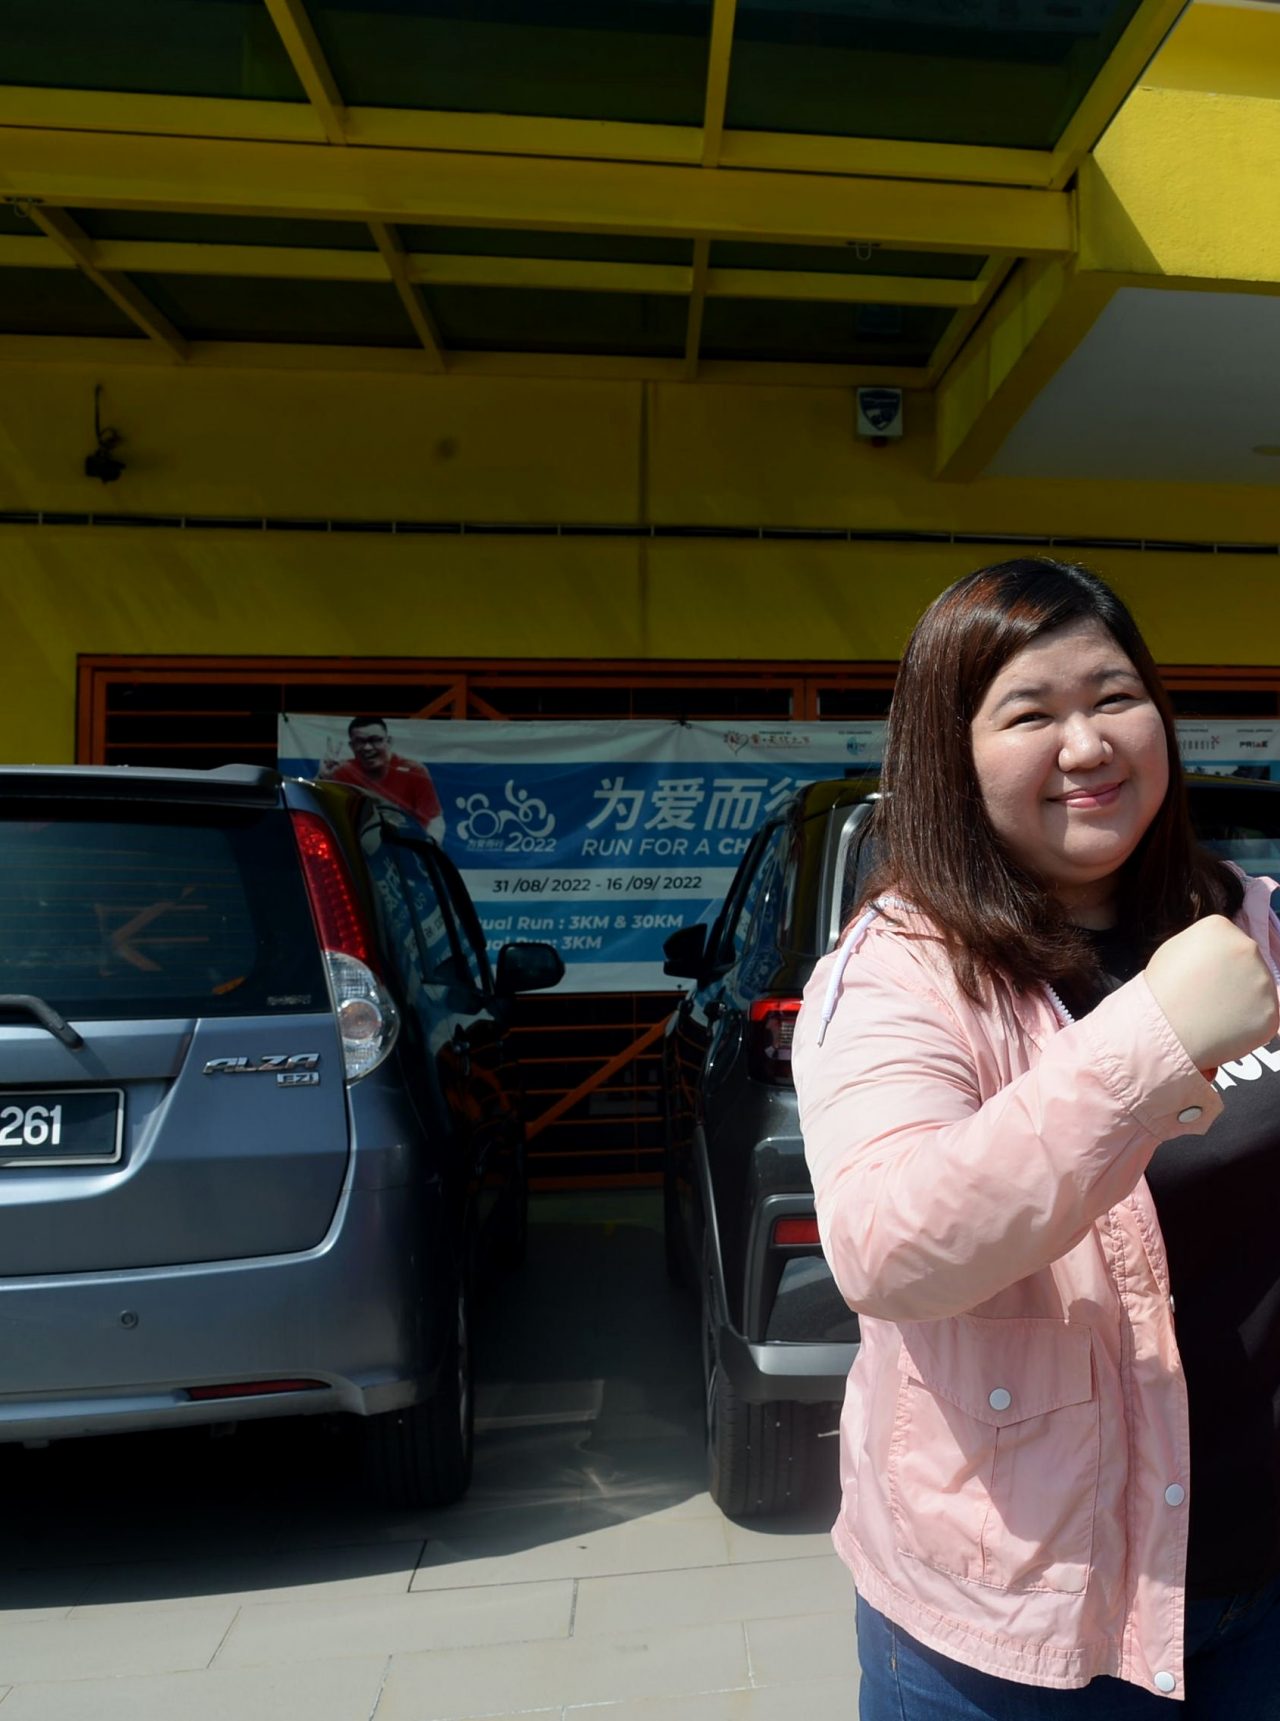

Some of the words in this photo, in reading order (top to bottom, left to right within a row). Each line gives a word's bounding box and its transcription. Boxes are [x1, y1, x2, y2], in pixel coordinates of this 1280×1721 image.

[505, 831, 558, 852] 2022
[581, 838, 631, 856] RUN
[639, 838, 688, 855] FOR
[693, 838, 711, 855] A
[552, 878, 591, 892] 2022
[663, 876, 702, 890] 2022
[568, 915, 609, 930] 3KM
[613, 915, 627, 929] &
[631, 914, 683, 929] 30KM
[561, 935, 603, 950] 3KM
[203, 1052, 321, 1075] ALZA
[0, 1104, 63, 1146] 261
